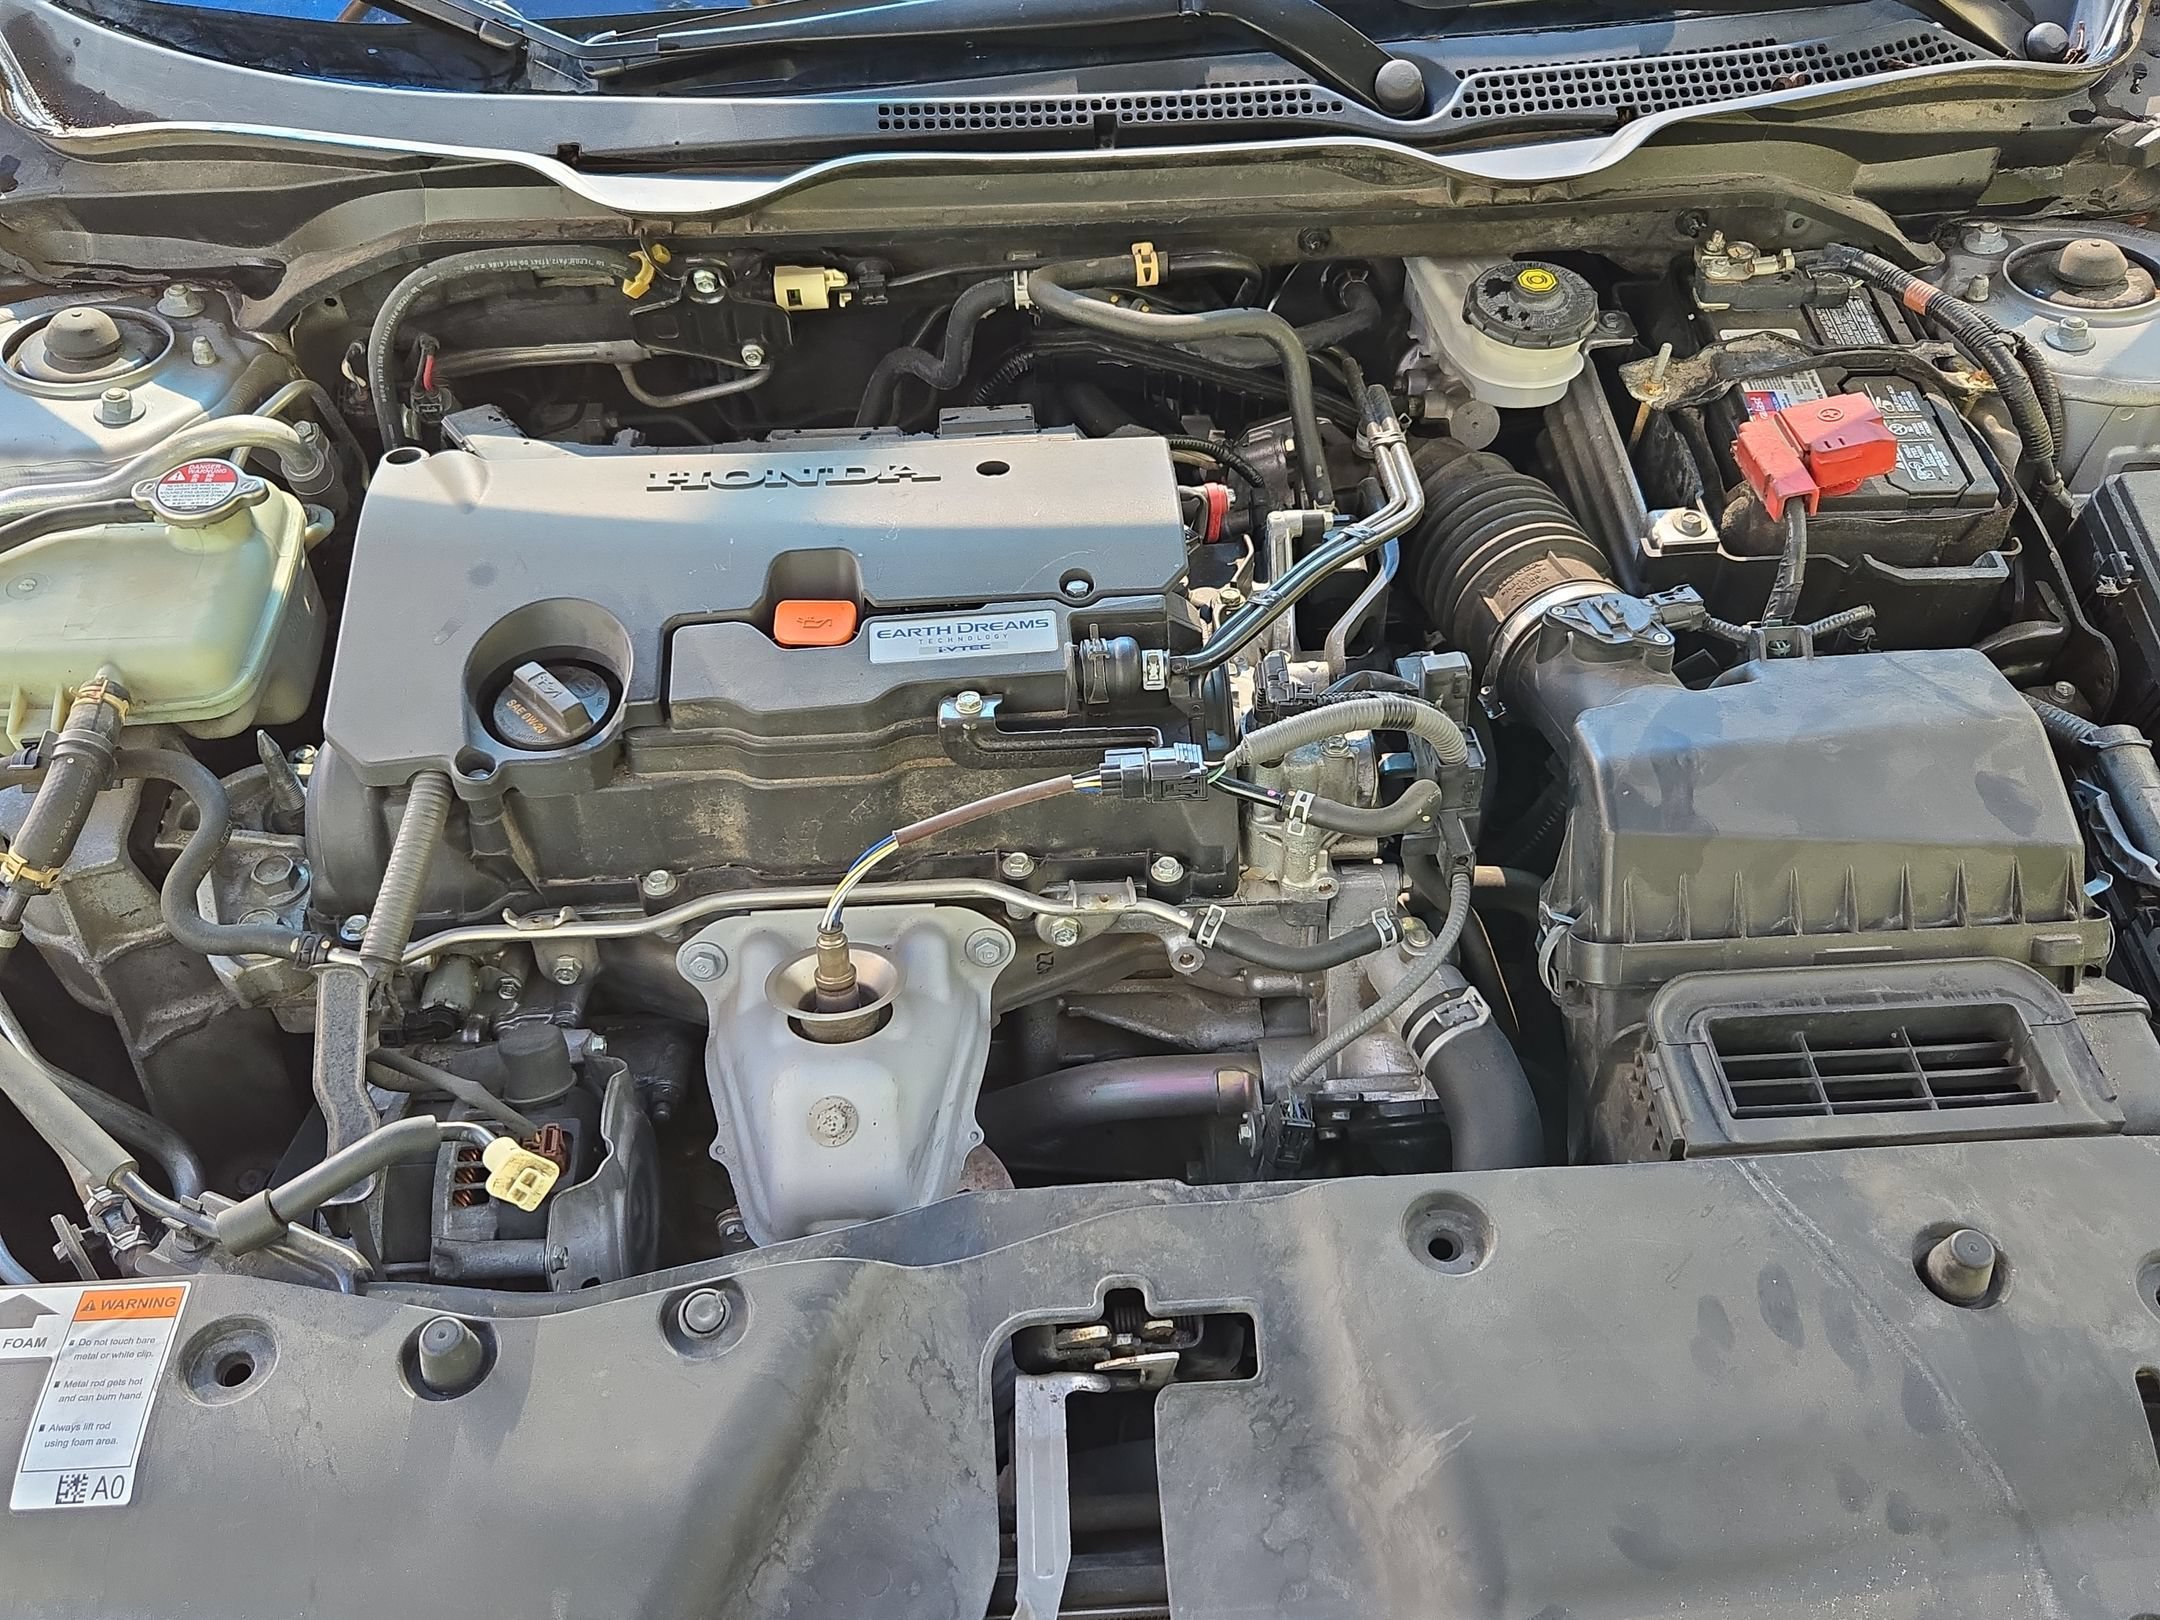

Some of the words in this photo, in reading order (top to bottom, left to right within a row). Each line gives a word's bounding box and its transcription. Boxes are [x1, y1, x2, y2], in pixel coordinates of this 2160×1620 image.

[646, 464, 942, 492] HONDA
[876, 624, 952, 640] EARTH
[956, 617, 1050, 633] DREAMS
[918, 632, 1009, 645] TECHNOLOGY
[506, 699, 527, 715] SAE
[100, 1296, 177, 1312] WARNING
[3, 1336, 48, 1349] FOAM
[78, 1338, 93, 1347] Do
[94, 1338, 108, 1347] not
[109, 1337, 135, 1346] touch
[136, 1336, 156, 1345] bare
[73, 1352, 99, 1361] metal
[111, 1351, 135, 1360] white
[136, 1350, 155, 1361] clip.
[63, 1380, 90, 1389] Metal
[91, 1379, 106, 1388] rod
[107, 1379, 127, 1390] gets
[128, 1377, 144, 1387] hot
[58, 1393, 76, 1403] and
[78, 1394, 95, 1402] can
[118, 1391, 144, 1401] hand.
[48, 1423, 81, 1433] Always
[82, 1422, 94, 1431] lift
[95, 1422, 112, 1431] rod
[44, 1439, 69, 1449] using
[70, 1438, 94, 1447] foam
[95, 1437, 119, 1446] area.
